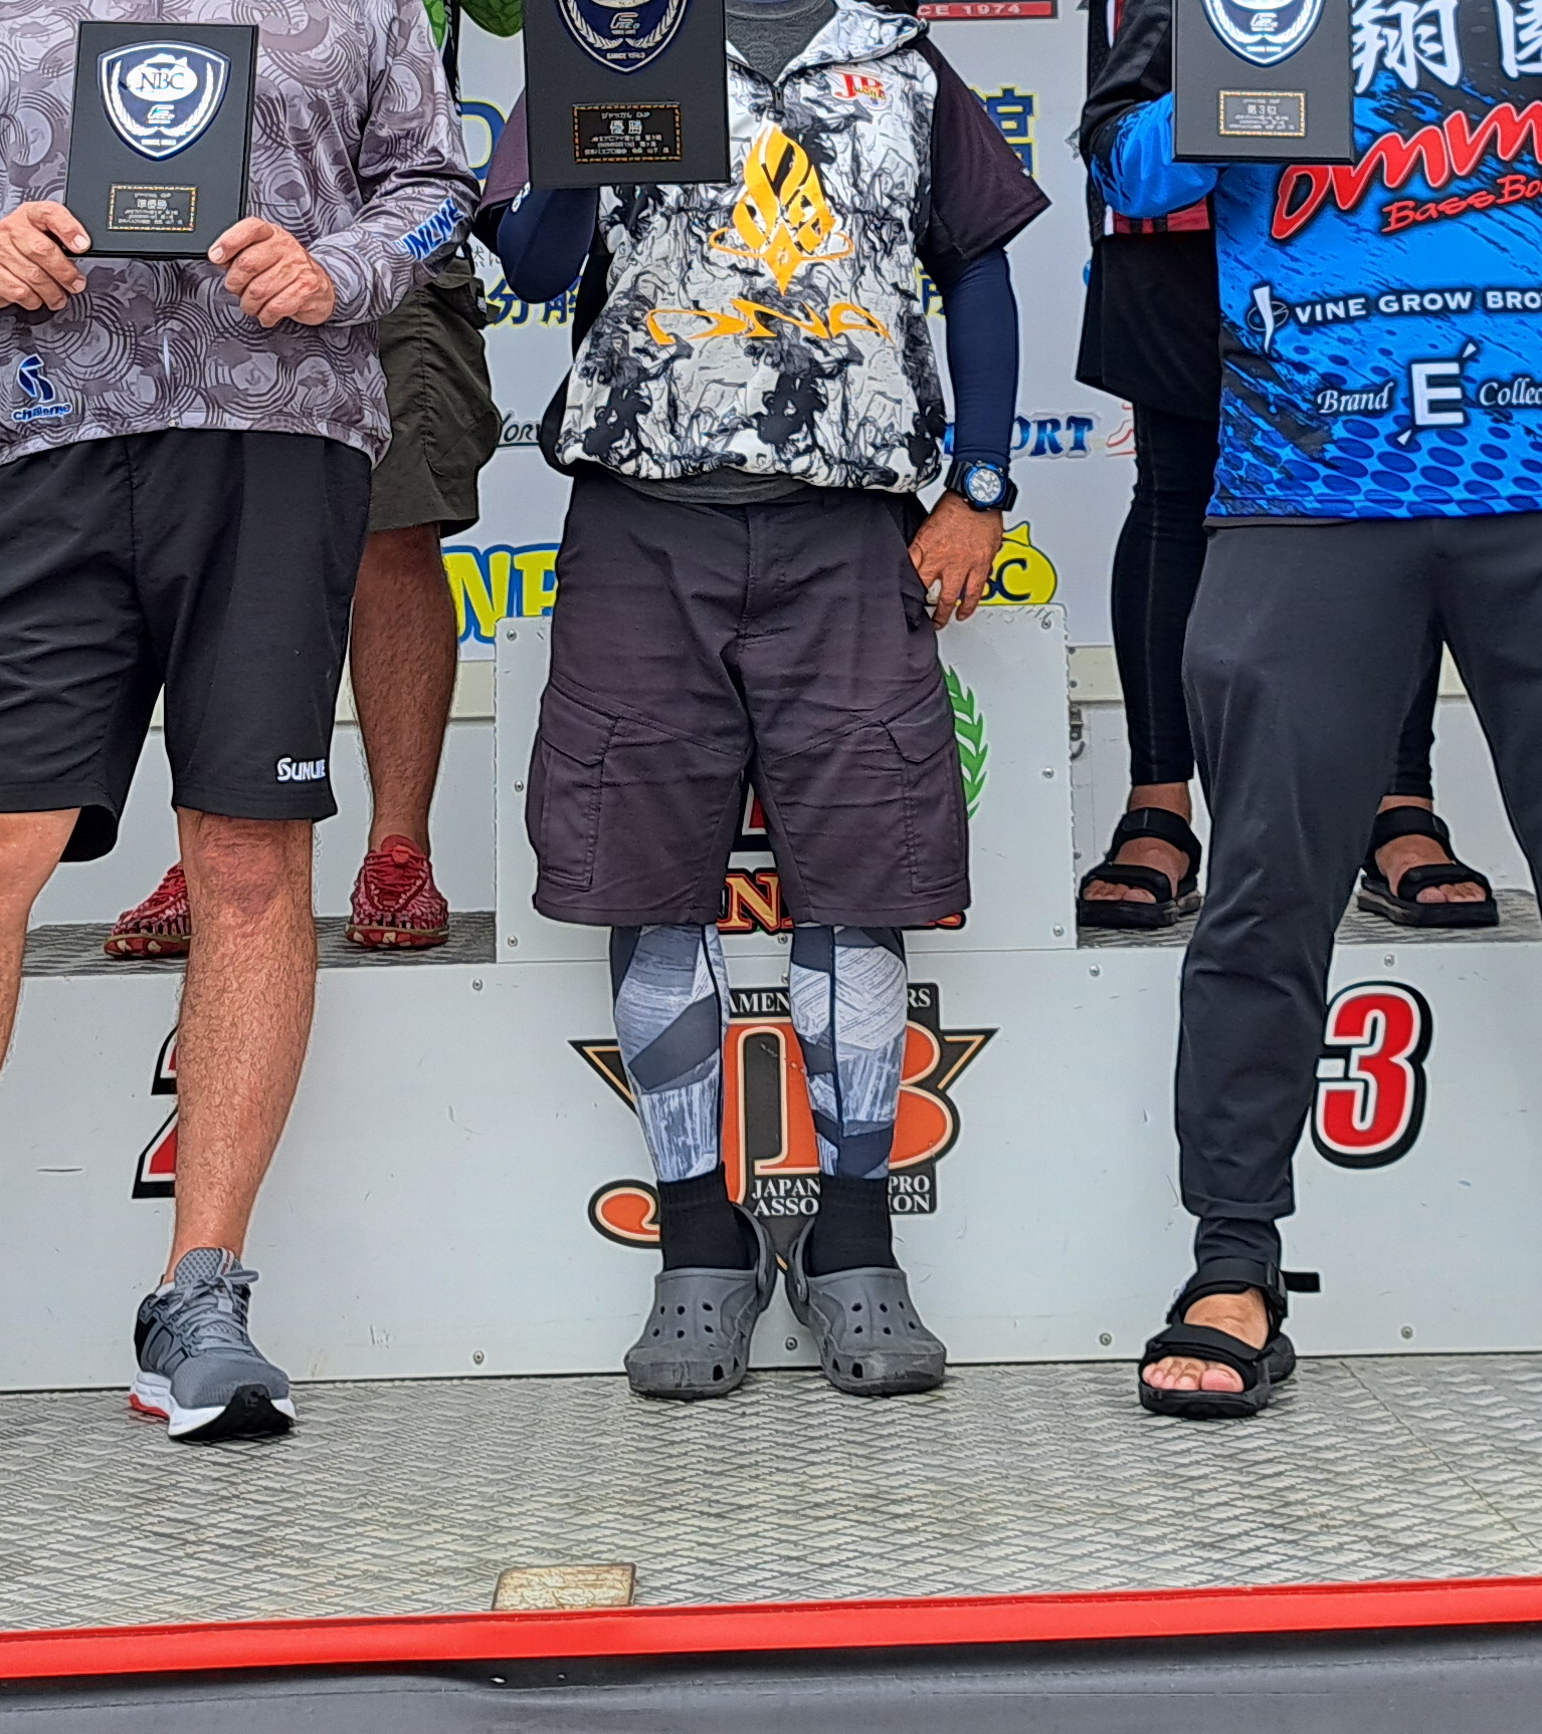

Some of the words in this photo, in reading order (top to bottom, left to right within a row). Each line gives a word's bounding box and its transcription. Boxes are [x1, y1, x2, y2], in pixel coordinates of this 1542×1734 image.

[964, 3, 1022, 17] 1974
[138, 71, 185, 91] NBC
[1381, 190, 1496, 233] Bass
[1295, 296, 1367, 324] VINE
[1378, 290, 1473, 315] GROW
[1316, 384, 1394, 415] Brand
[1410, 361, 1466, 428] E
[1316, 980, 1432, 1169] 3
[888, 1175, 931, 1196] PRO
